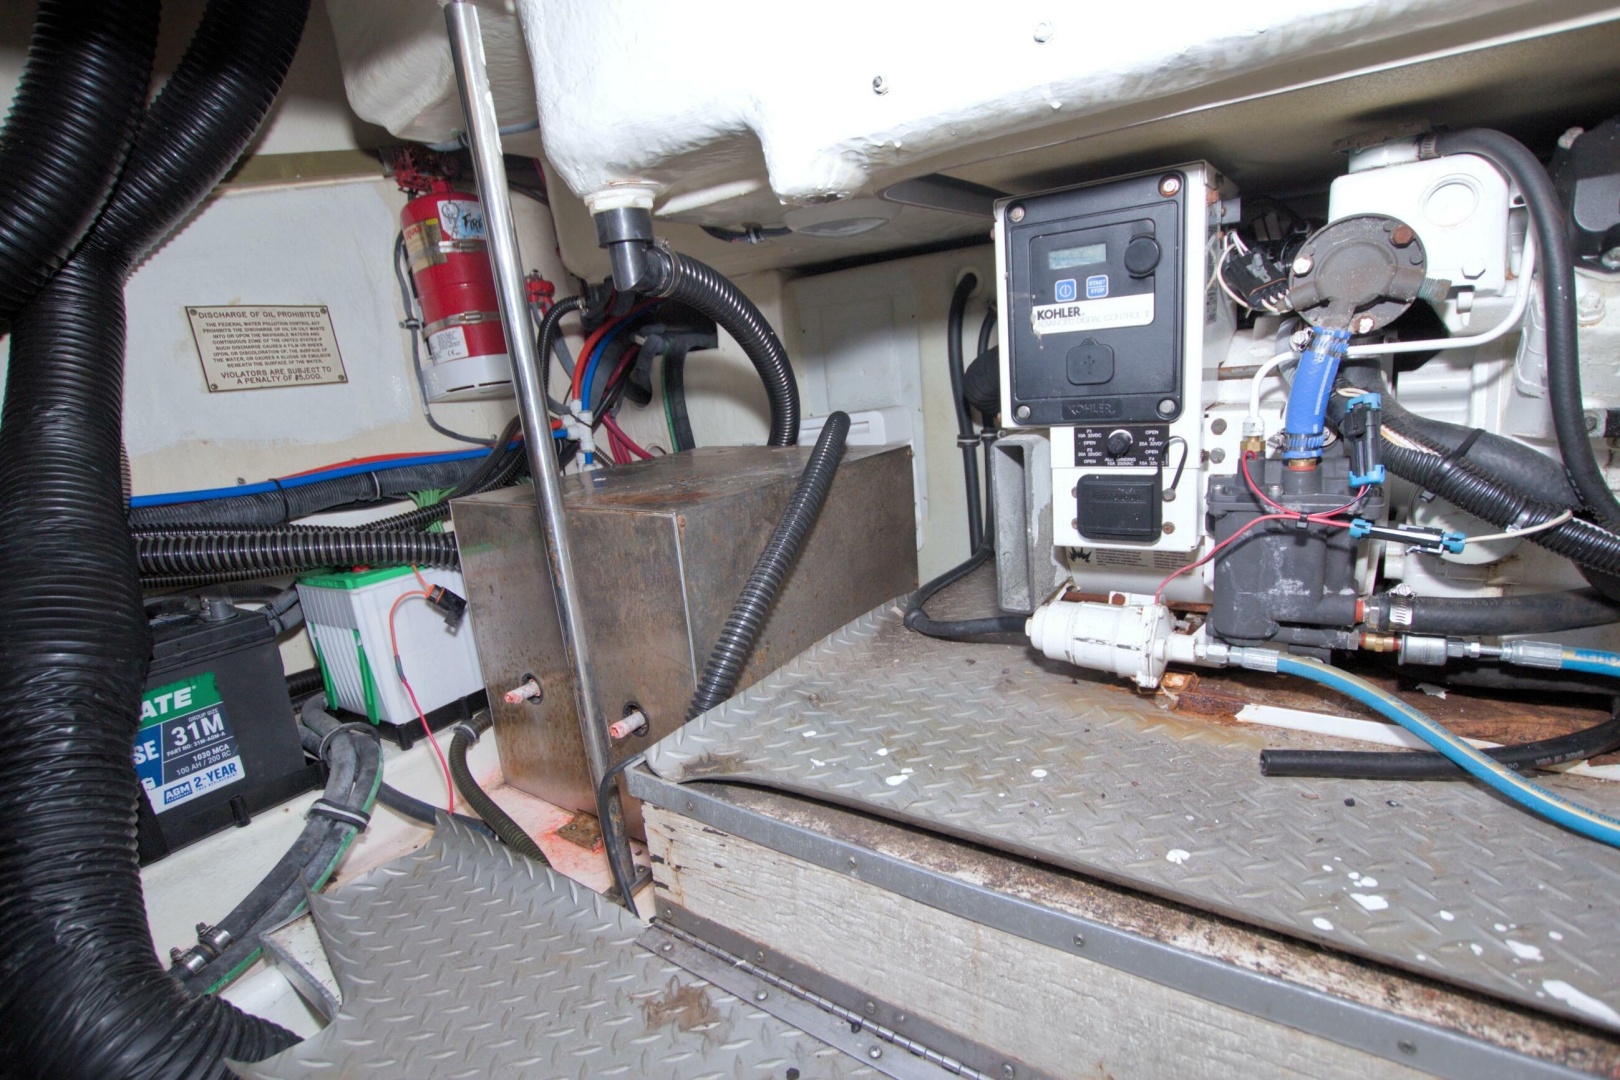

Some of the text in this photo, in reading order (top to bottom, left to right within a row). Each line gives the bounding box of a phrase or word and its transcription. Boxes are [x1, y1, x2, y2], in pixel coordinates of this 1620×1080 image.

[198, 311, 247, 319] DISCHARGE
[1037, 306, 1081, 320] KOHLER
[1037, 318, 1075, 328] ADVANCED
[1076, 315, 1100, 324] DIGITAL
[1104, 311, 1140, 321] CONTROL
[220, 369, 268, 379] VIOLATORS
[269, 368, 285, 376] ARE
[287, 366, 320, 375] SUBJECT
[245, 376, 280, 384] PENALTY
[282, 374, 293, 382] OF
[188, 708, 219, 723] GROUP SIZE
[171, 712, 225, 747] 31M
[133, 740, 159, 765] SE
[167, 732, 226, 757] PART NO: 31M-AGM-A
[192, 743, 230, 762] 1030 MCA
[176, 767, 190, 776] 100
[191, 761, 202, 771] AH
[208, 754, 221, 765] 200
[221, 750, 232, 759] RC
[165, 762, 237, 799] AGM 2-YEAR
